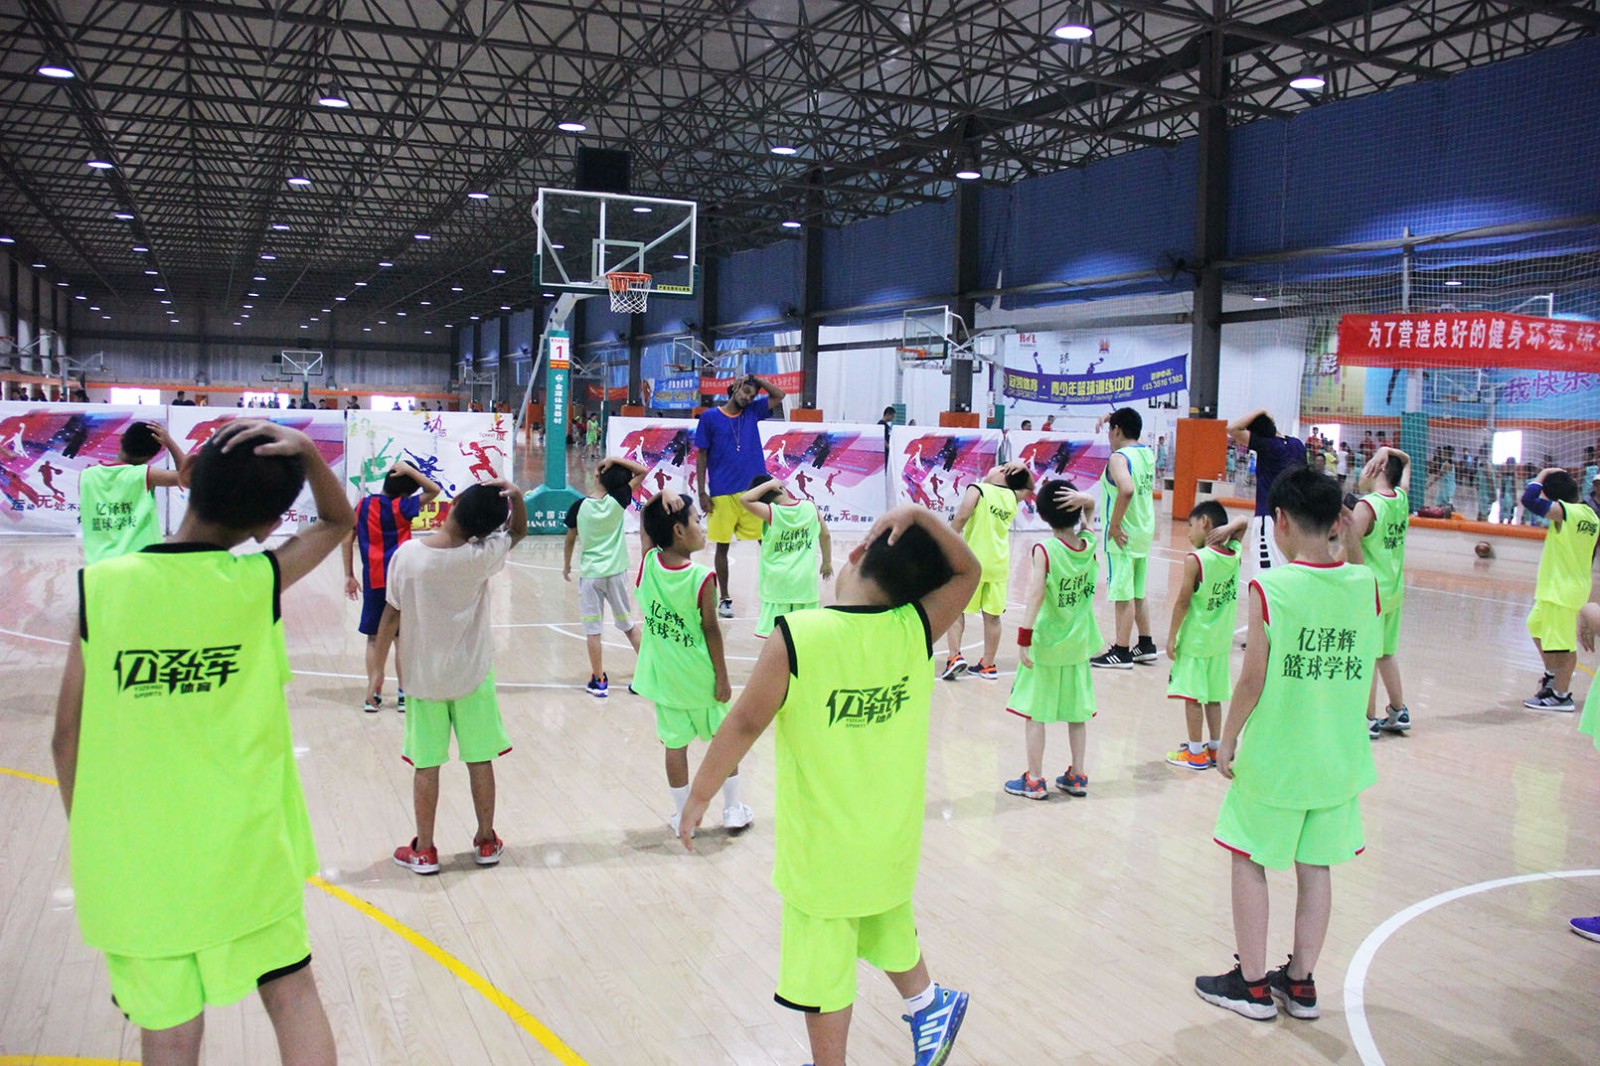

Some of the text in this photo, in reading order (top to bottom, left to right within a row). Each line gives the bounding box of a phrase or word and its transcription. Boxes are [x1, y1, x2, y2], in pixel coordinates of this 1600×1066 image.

[556, 345, 562, 358] 1
[1297, 626, 1357, 653] 亿泽辉
[1281, 653, 1362, 681] 篮球学校
